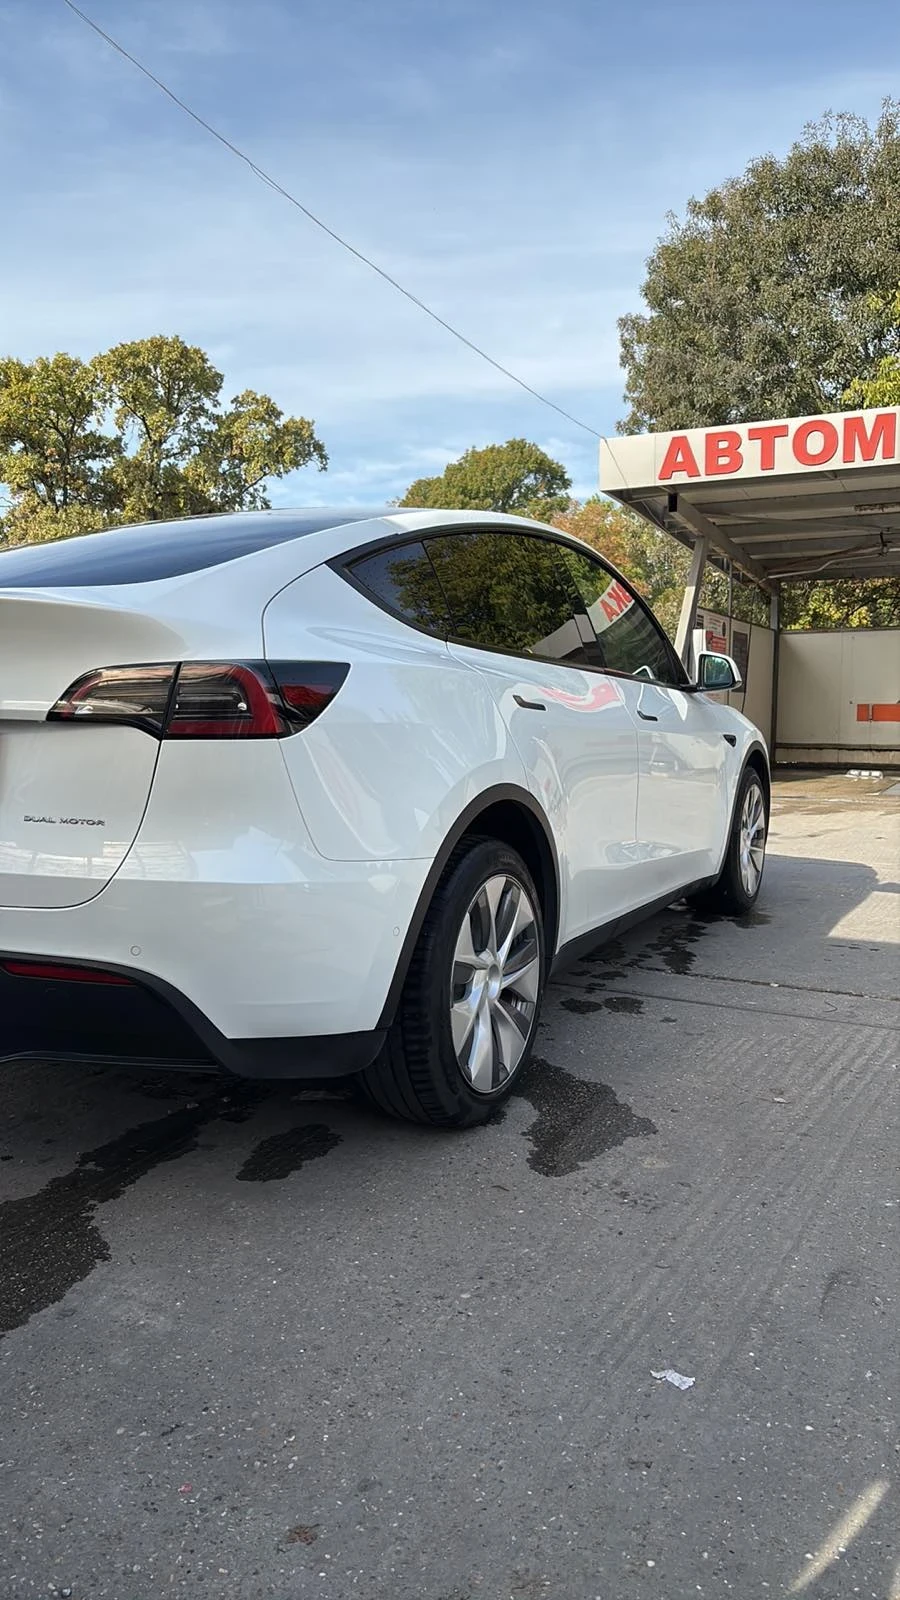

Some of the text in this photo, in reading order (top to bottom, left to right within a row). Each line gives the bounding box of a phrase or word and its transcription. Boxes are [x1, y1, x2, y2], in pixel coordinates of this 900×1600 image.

[658, 412, 897, 481] АВТОМ
[23, 815, 105, 826] DUAL MOTOR
